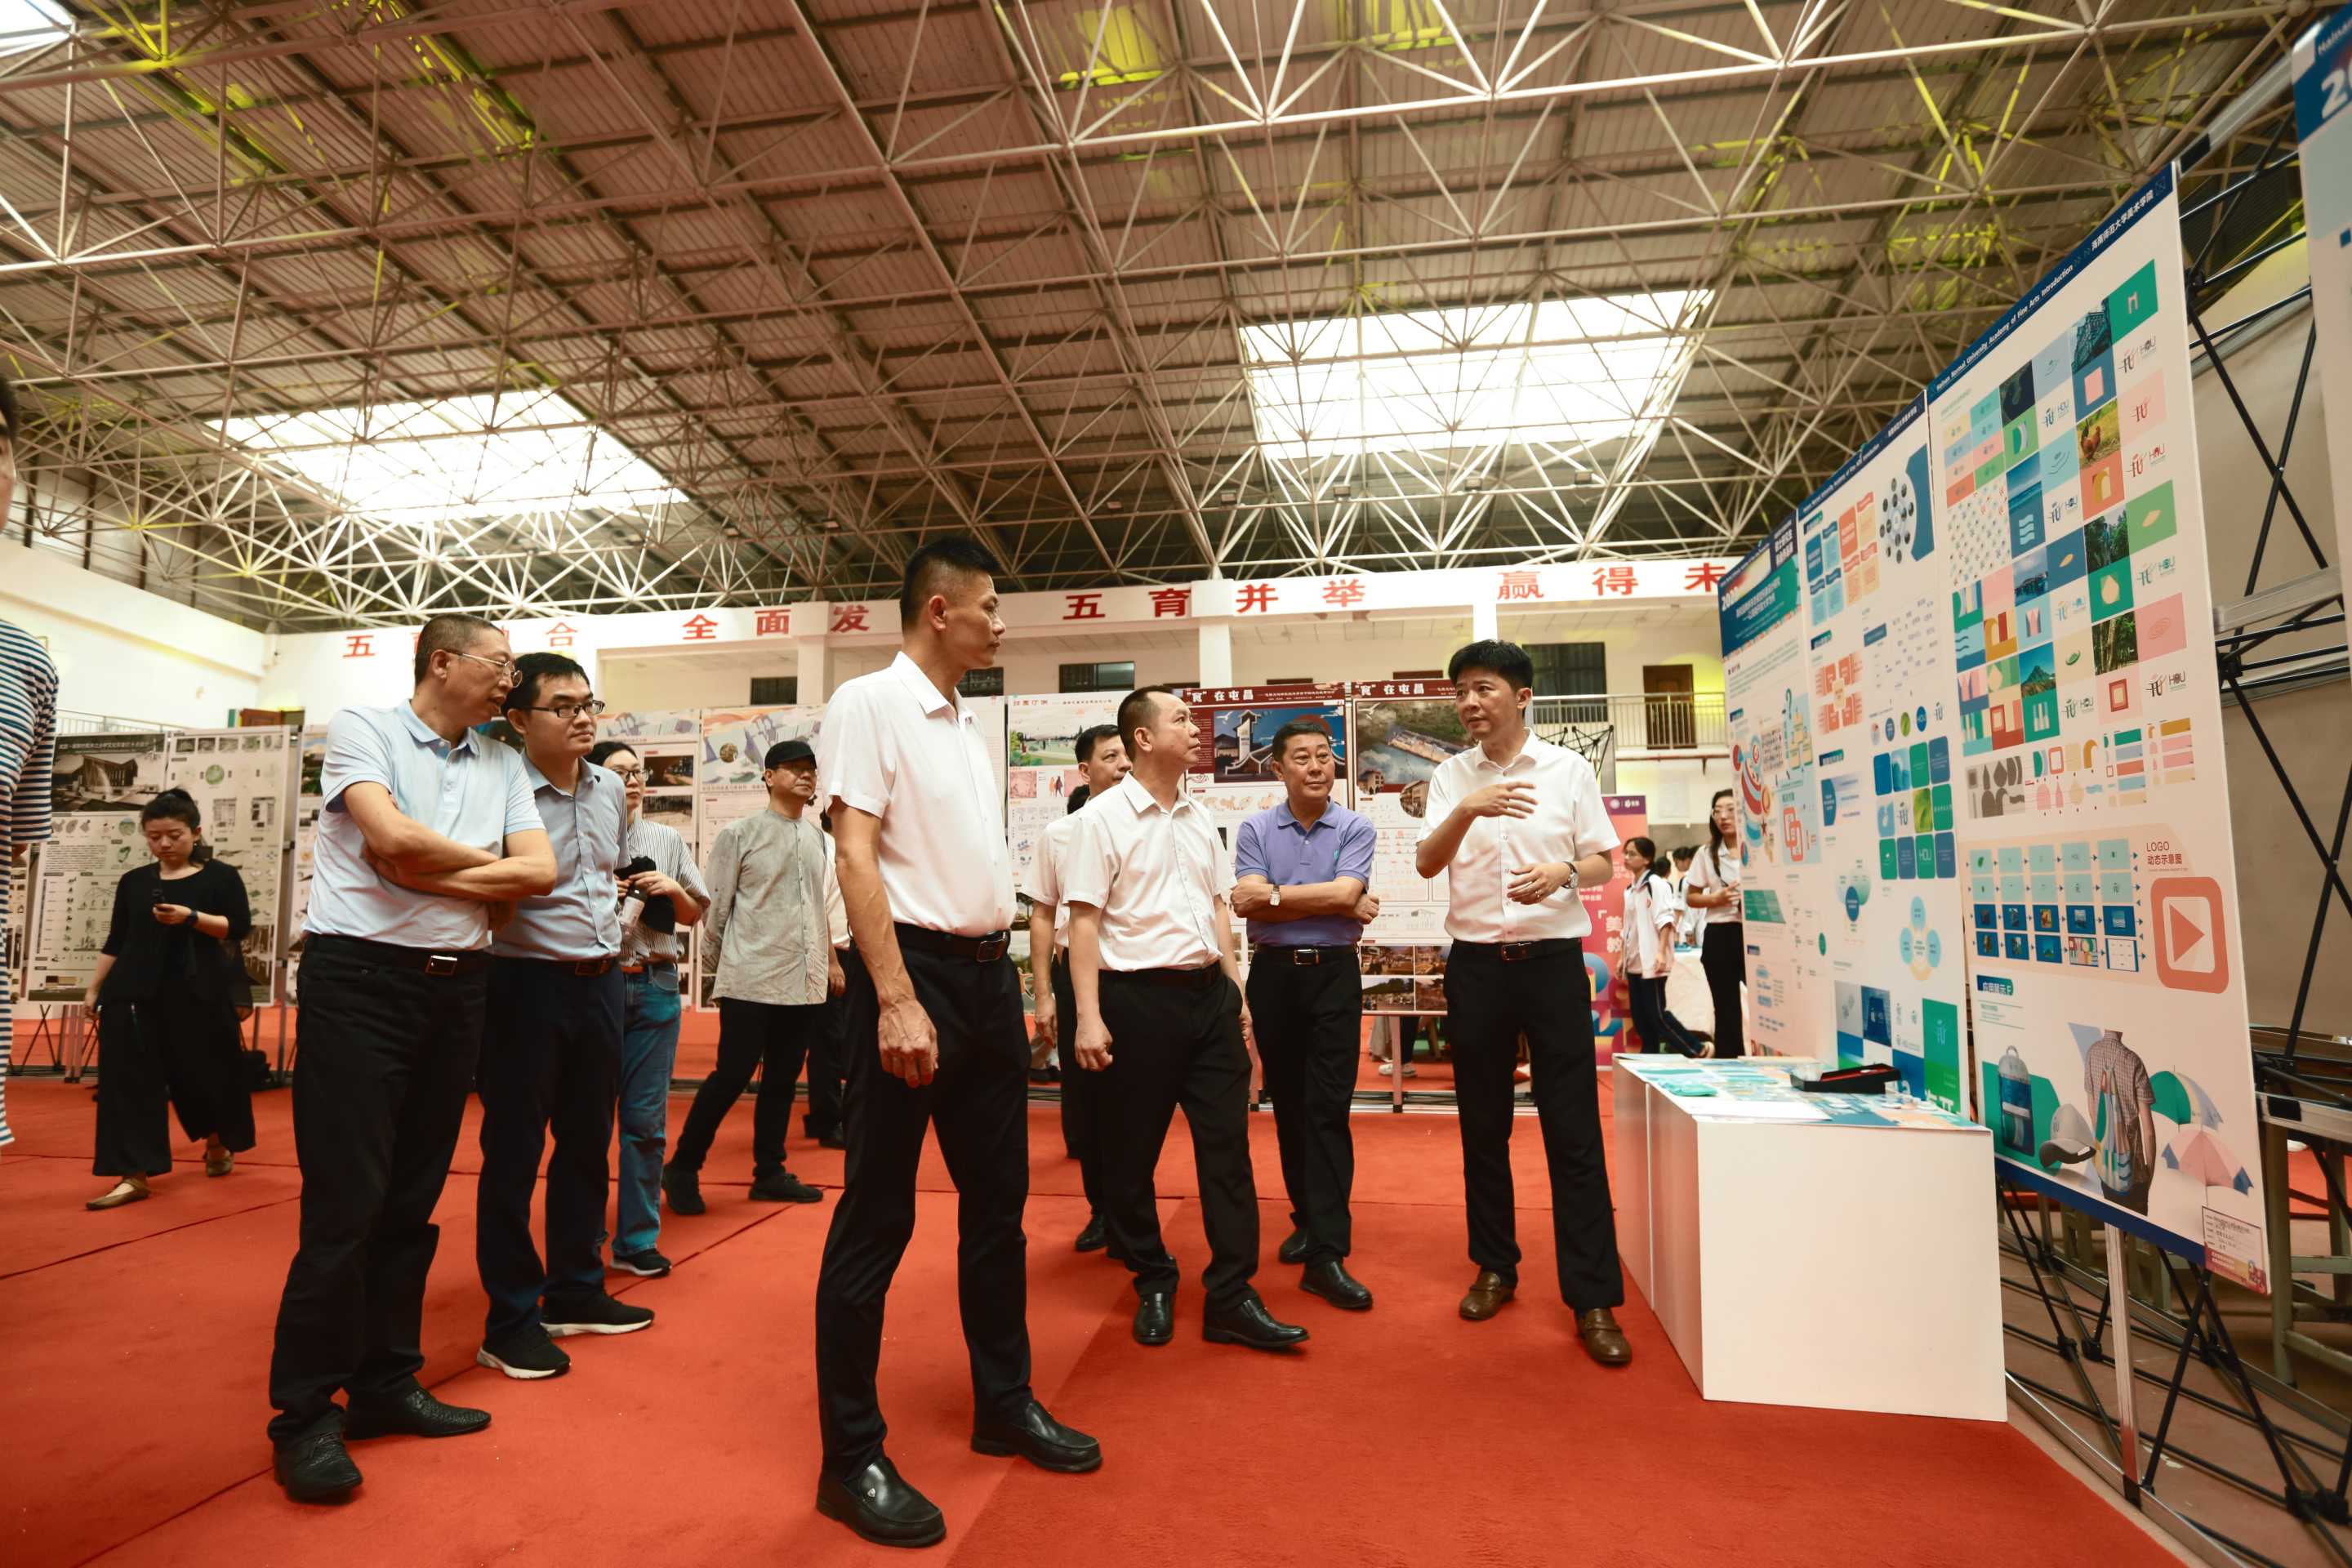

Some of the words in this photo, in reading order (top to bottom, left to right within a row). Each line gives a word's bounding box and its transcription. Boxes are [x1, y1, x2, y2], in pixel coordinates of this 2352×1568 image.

[2017, 305, 2029, 318] Fine
[2029, 295, 2040, 308] Arts
[2042, 265, 2074, 296] Introduction
[1062, 578, 1365, 620] 五育并举
[2146, 841, 2170, 852] LOGO
[2147, 853, 2183, 865] 动态示意图
